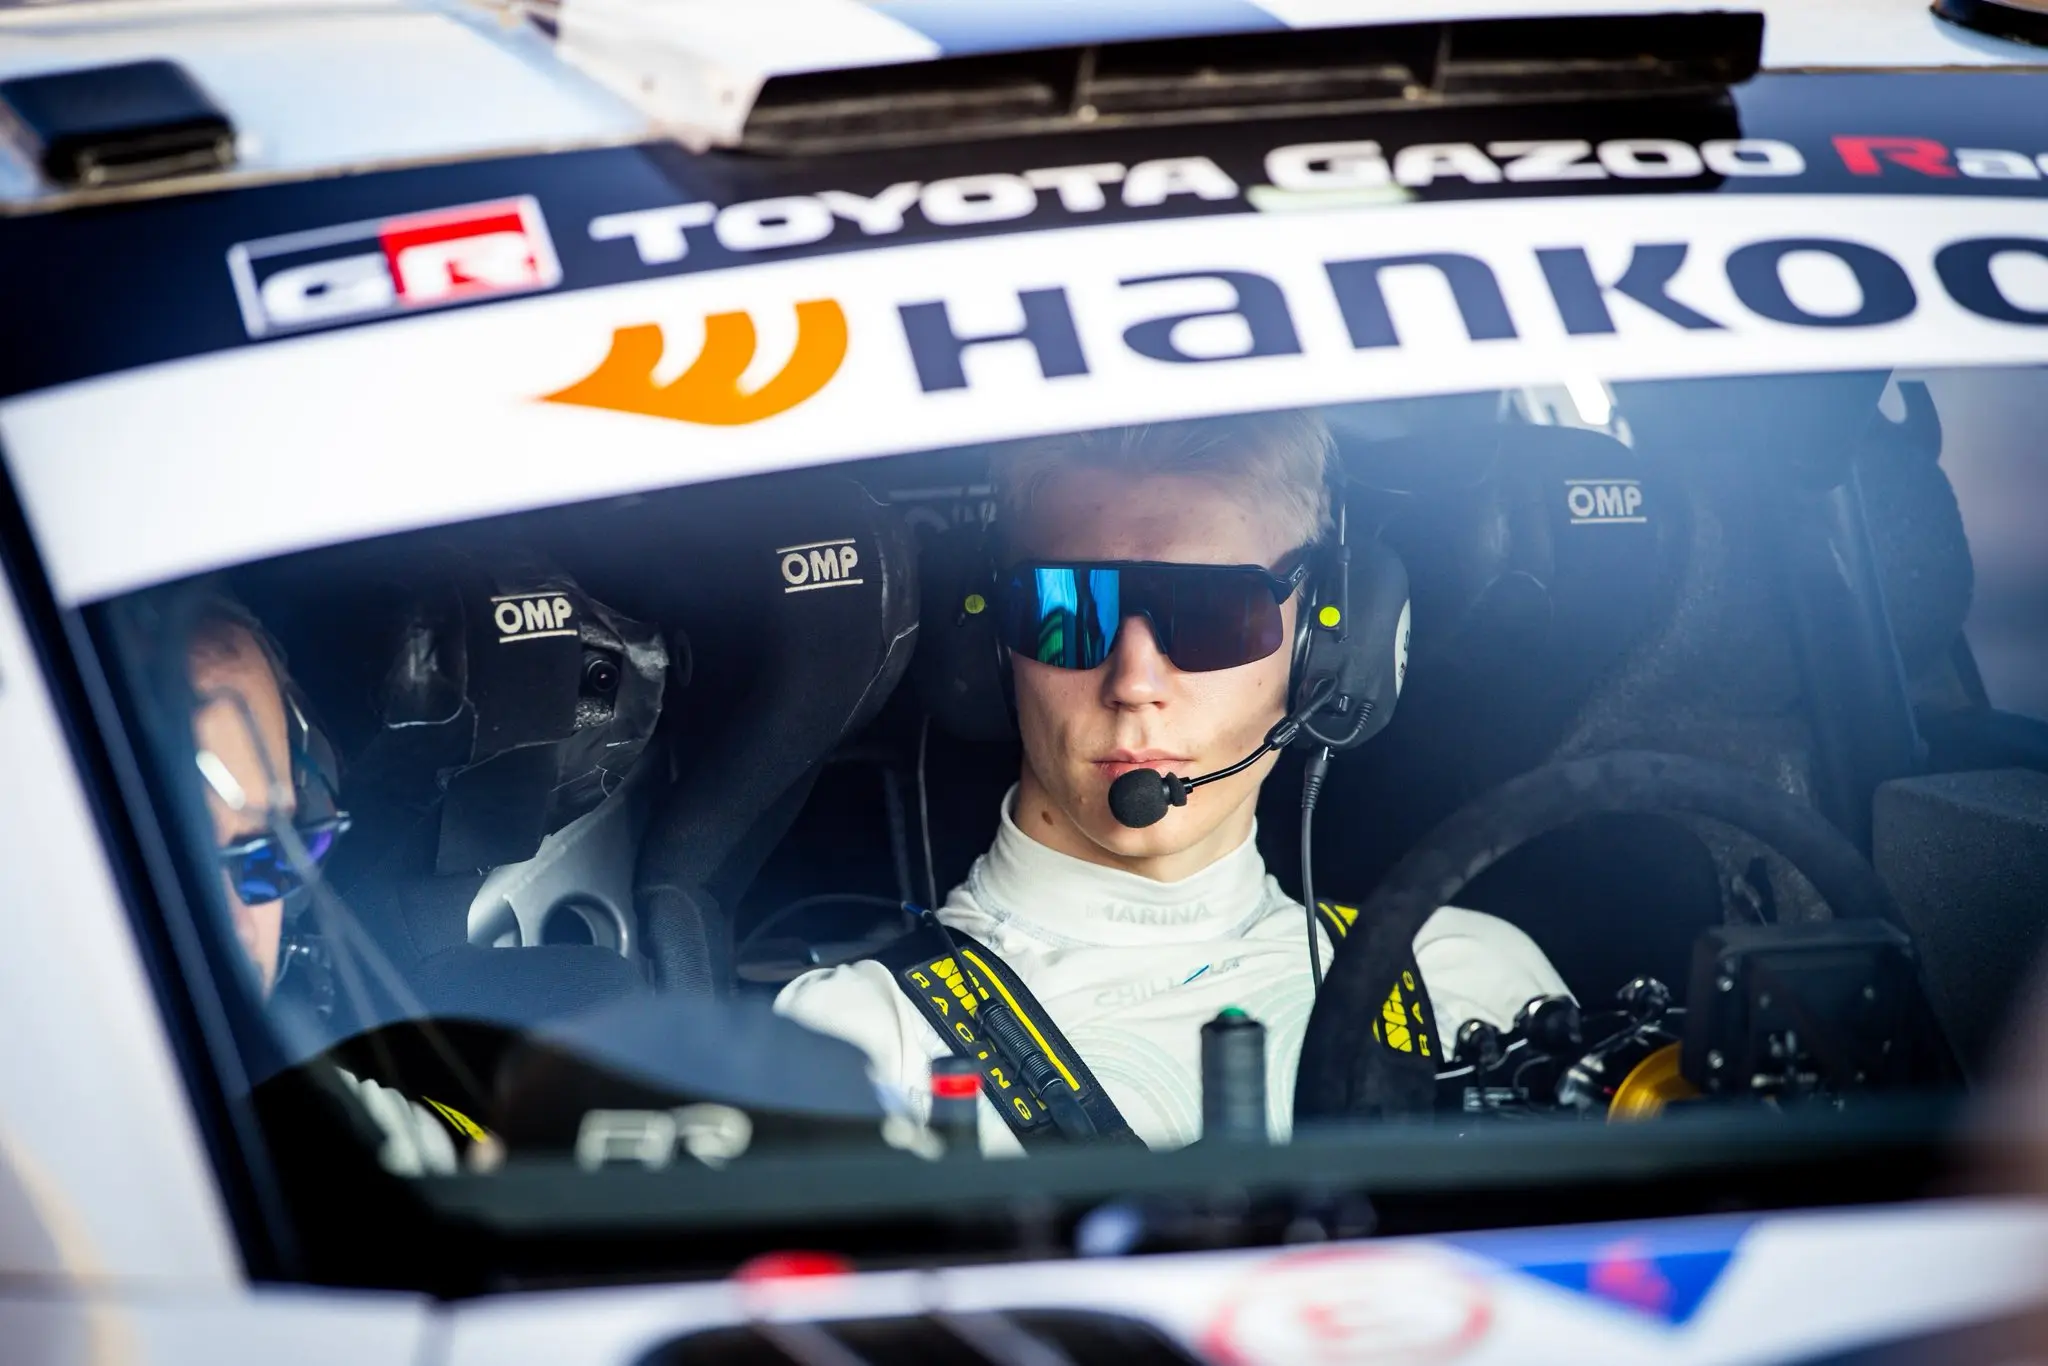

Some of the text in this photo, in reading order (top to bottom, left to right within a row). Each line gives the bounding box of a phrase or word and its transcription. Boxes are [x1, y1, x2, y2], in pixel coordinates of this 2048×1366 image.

[588, 134, 2048, 266] TOYOTA GAZOO Ra
[259, 228, 542, 326] GR
[1567, 485, 1643, 518] OMP
[780, 544, 859, 585] OMP
[494, 596, 573, 634] OMP
[911, 971, 1033, 1121] RACING
